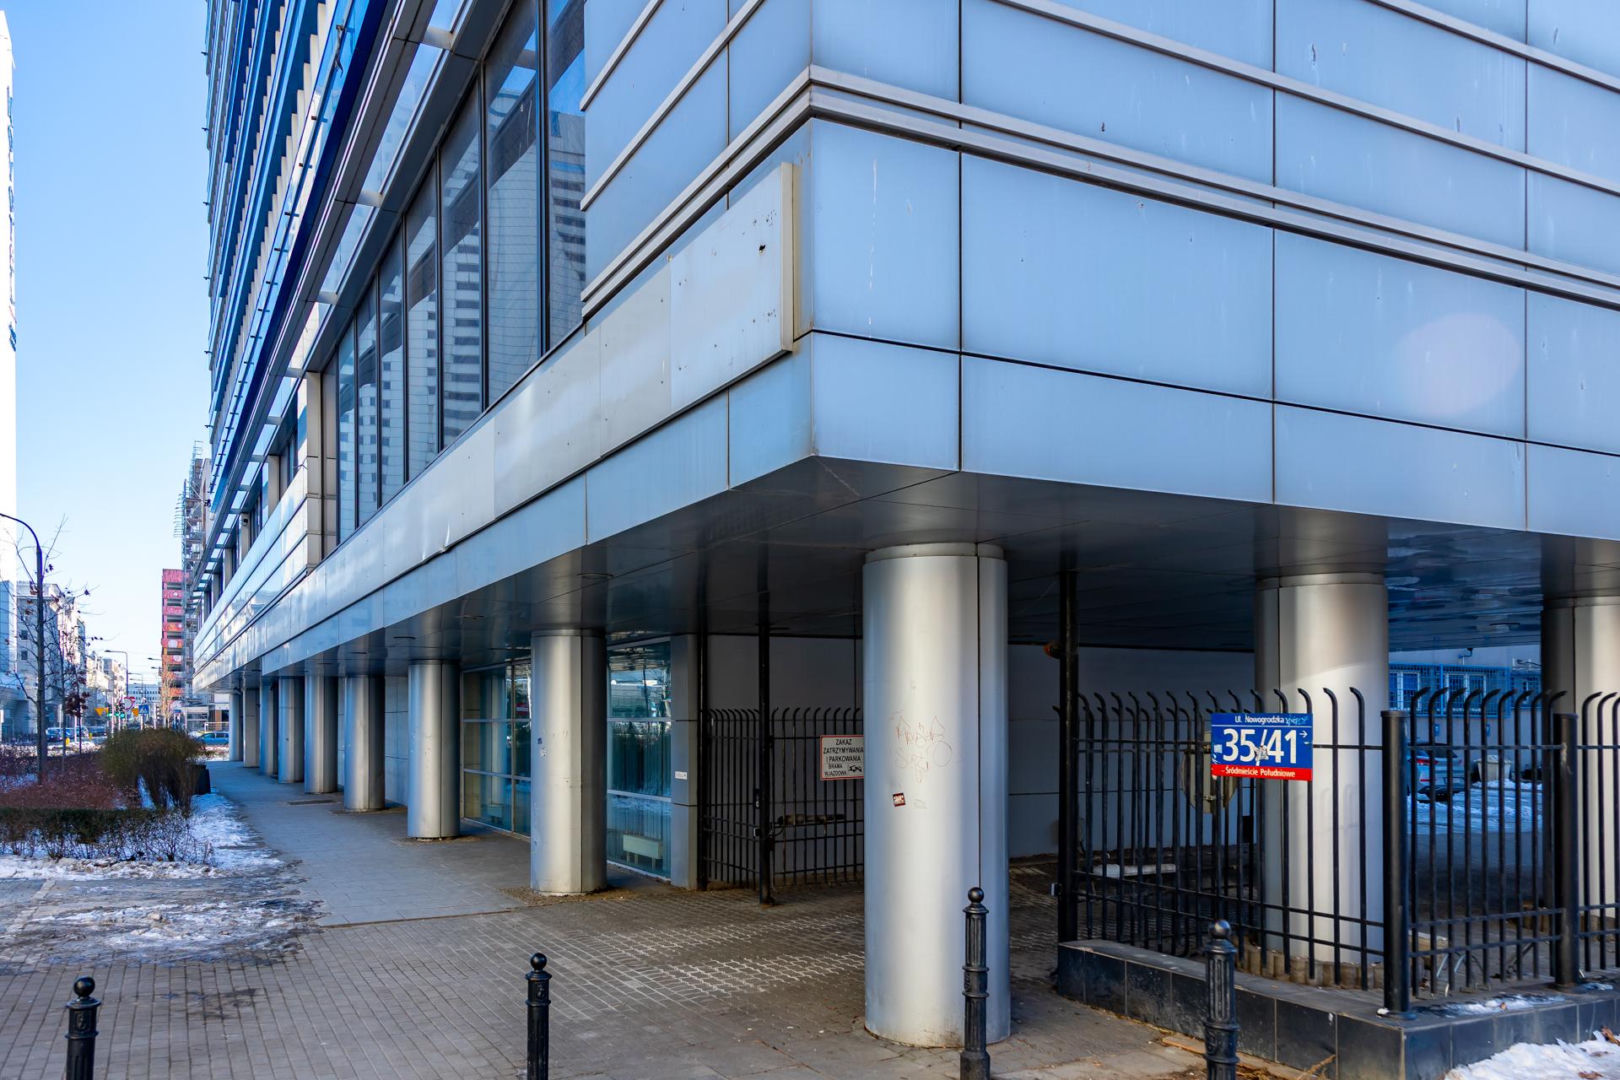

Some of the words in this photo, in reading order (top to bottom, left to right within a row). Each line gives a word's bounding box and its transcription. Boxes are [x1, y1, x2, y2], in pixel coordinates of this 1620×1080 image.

[1244, 715, 1285, 725] Nowogrodzka
[1223, 728, 1297, 766] 35/41
[1225, 766, 1258, 776] Śródmieście
[1260, 768, 1295, 777] Południowe
